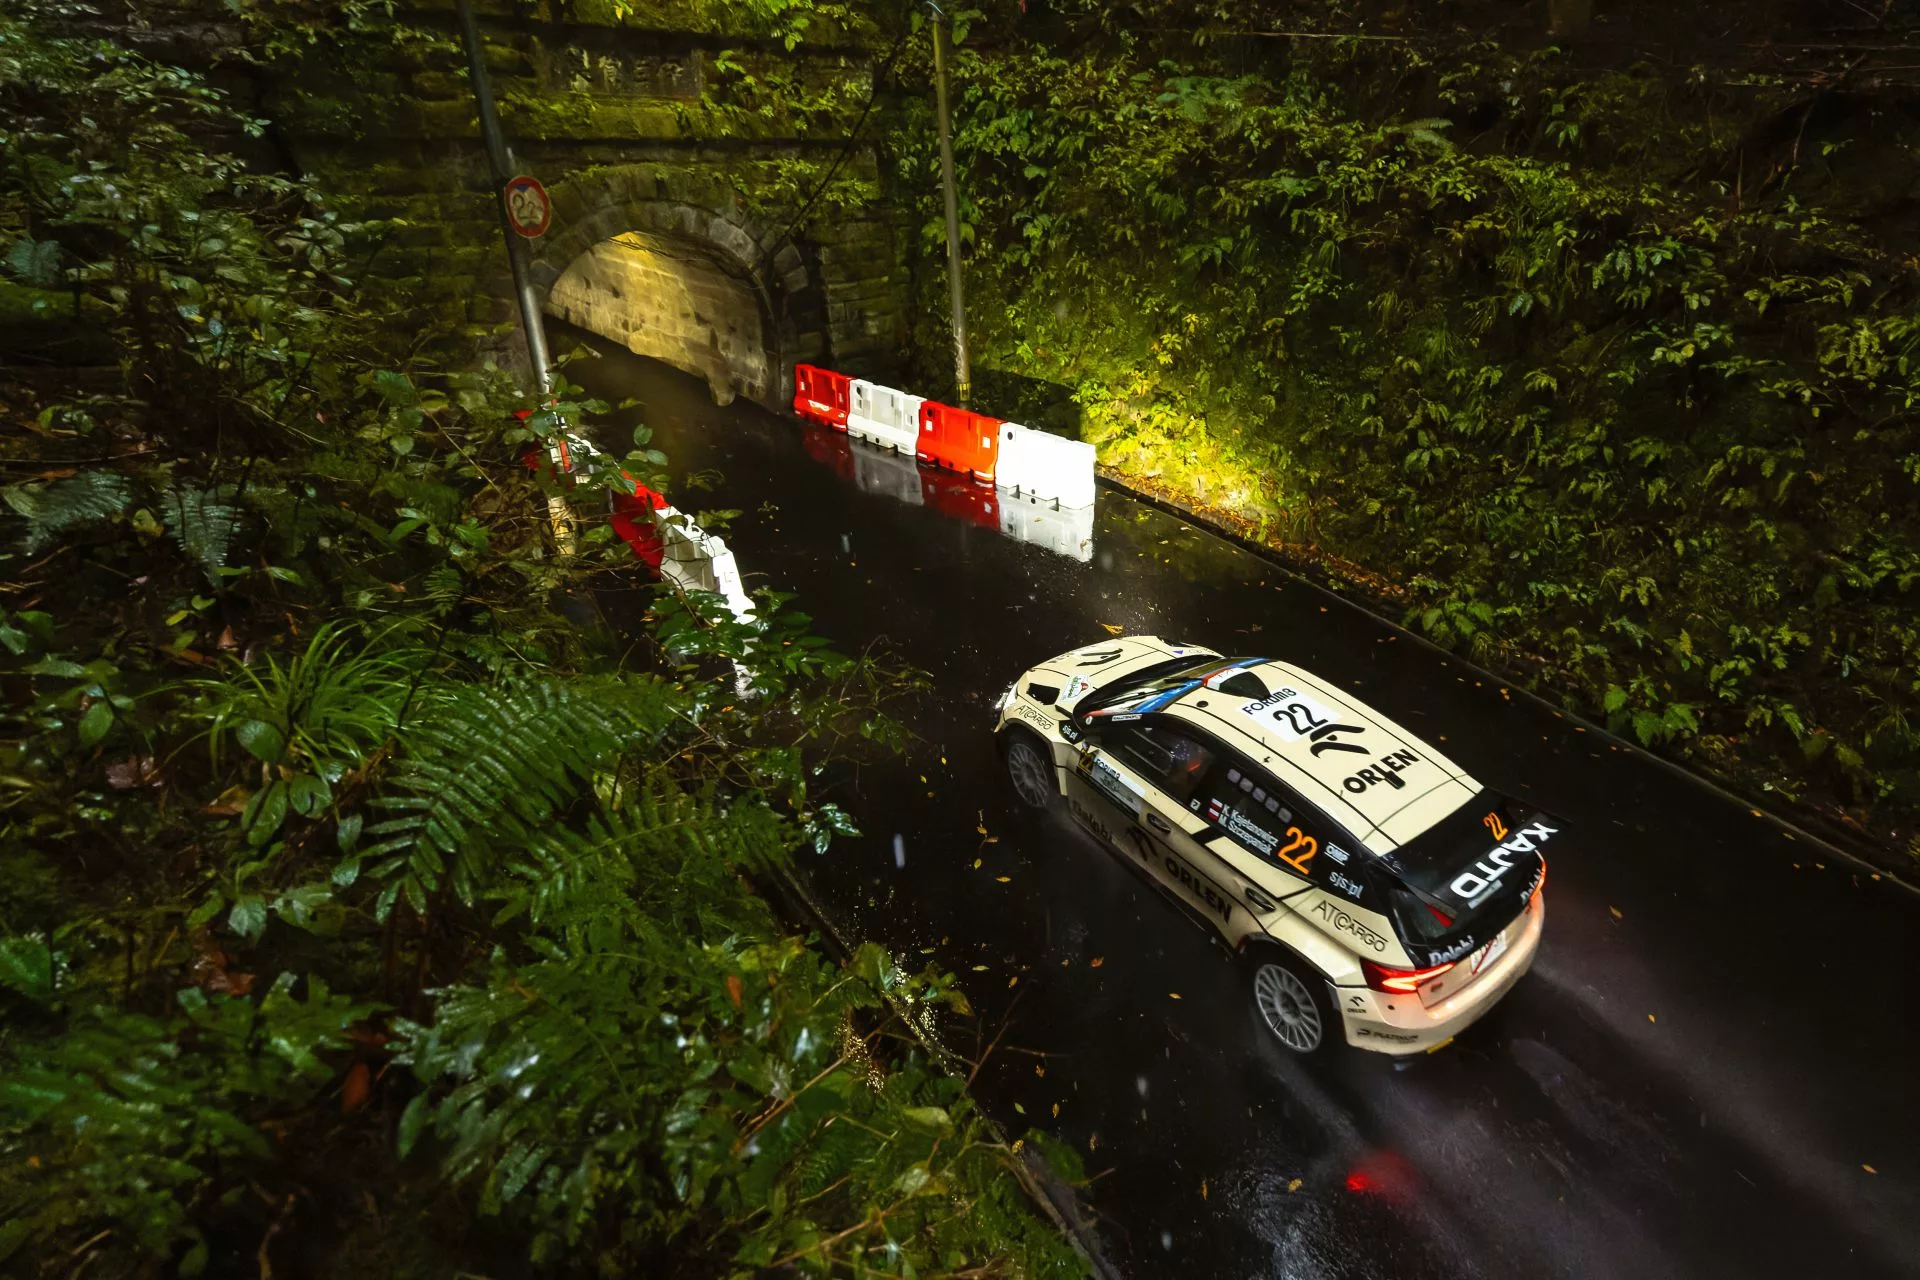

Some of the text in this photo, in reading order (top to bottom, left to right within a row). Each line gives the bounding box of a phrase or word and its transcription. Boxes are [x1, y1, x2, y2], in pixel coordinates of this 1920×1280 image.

[1014, 704, 1055, 731] ATCARGO
[1272, 703, 1329, 735] 22
[1343, 748, 1420, 794] ORLEN
[1483, 811, 1509, 841] 22
[1278, 826, 1318, 875] 22
[1450, 822, 1559, 899] KAJTO
[1165, 856, 1233, 925] ORLEN
[1329, 871, 1364, 900] sjs.pl
[1312, 899, 1389, 952] ATCARGO
